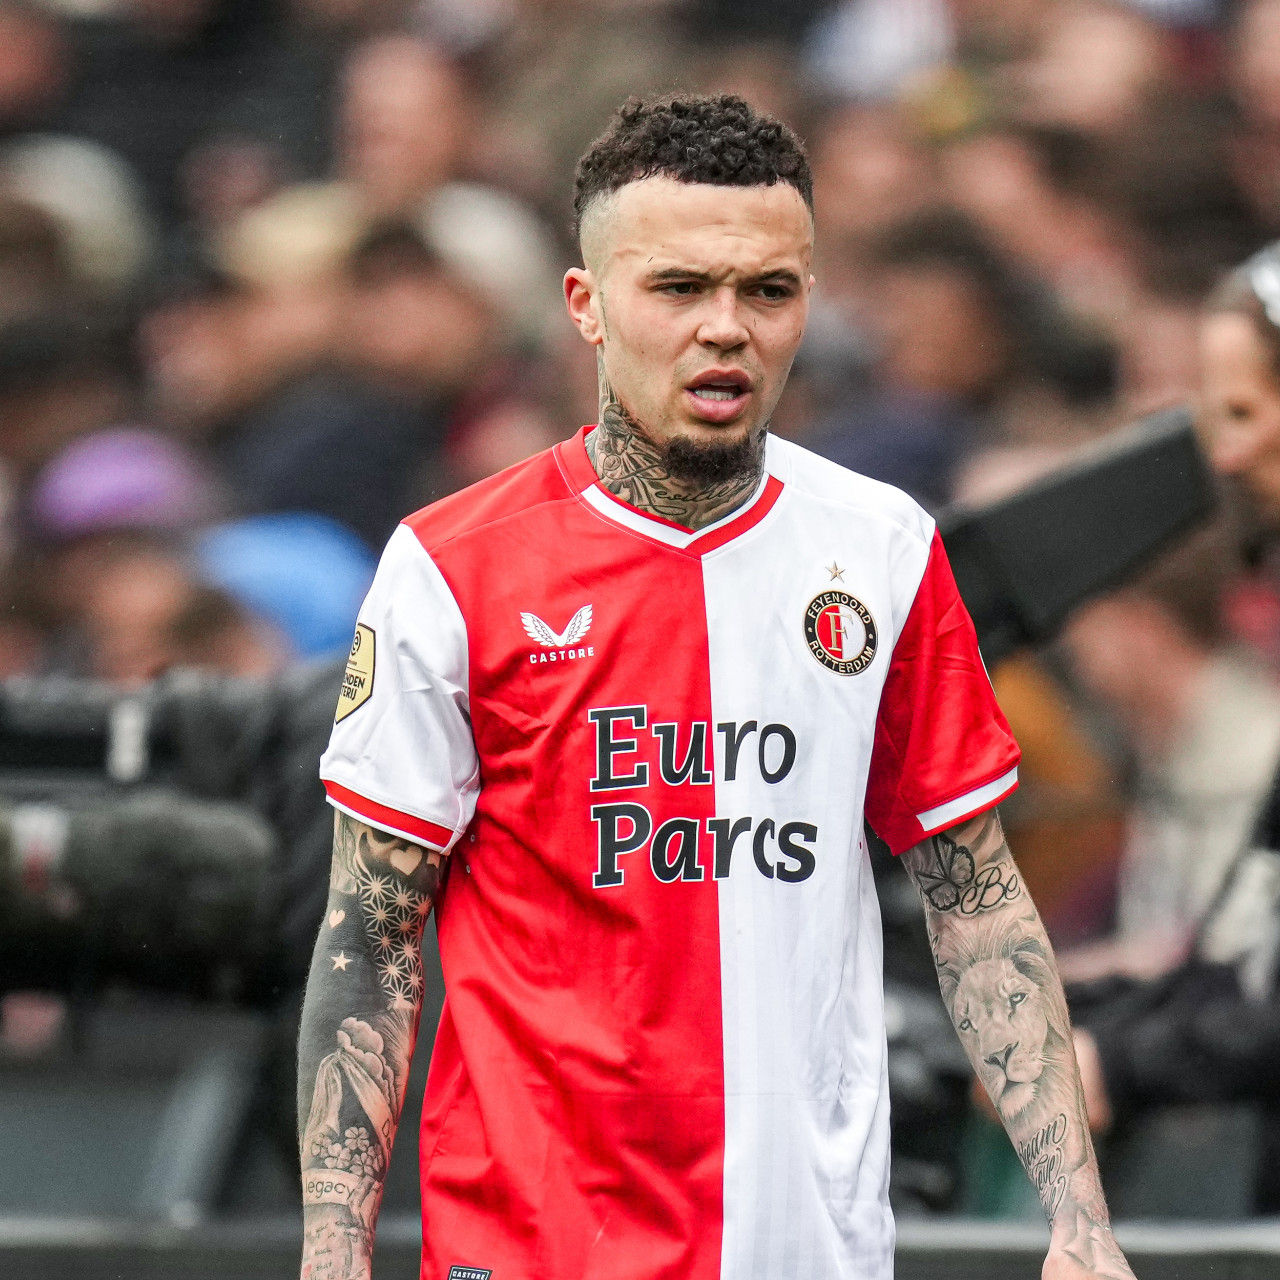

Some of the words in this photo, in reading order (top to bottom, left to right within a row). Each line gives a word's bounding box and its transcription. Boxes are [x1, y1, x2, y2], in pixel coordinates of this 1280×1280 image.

[807, 592, 871, 624] FEYENOORD
[825, 611, 854, 651] F
[529, 646, 594, 664] CASTORE
[809, 640, 875, 673] ROTTERDAM
[587, 704, 797, 793] Euro
[589, 801, 819, 890] Parcs
[960, 861, 1021, 915] Be
[305, 1177, 356, 1199] legacy
[452, 1270, 486, 1280] CASTORE
